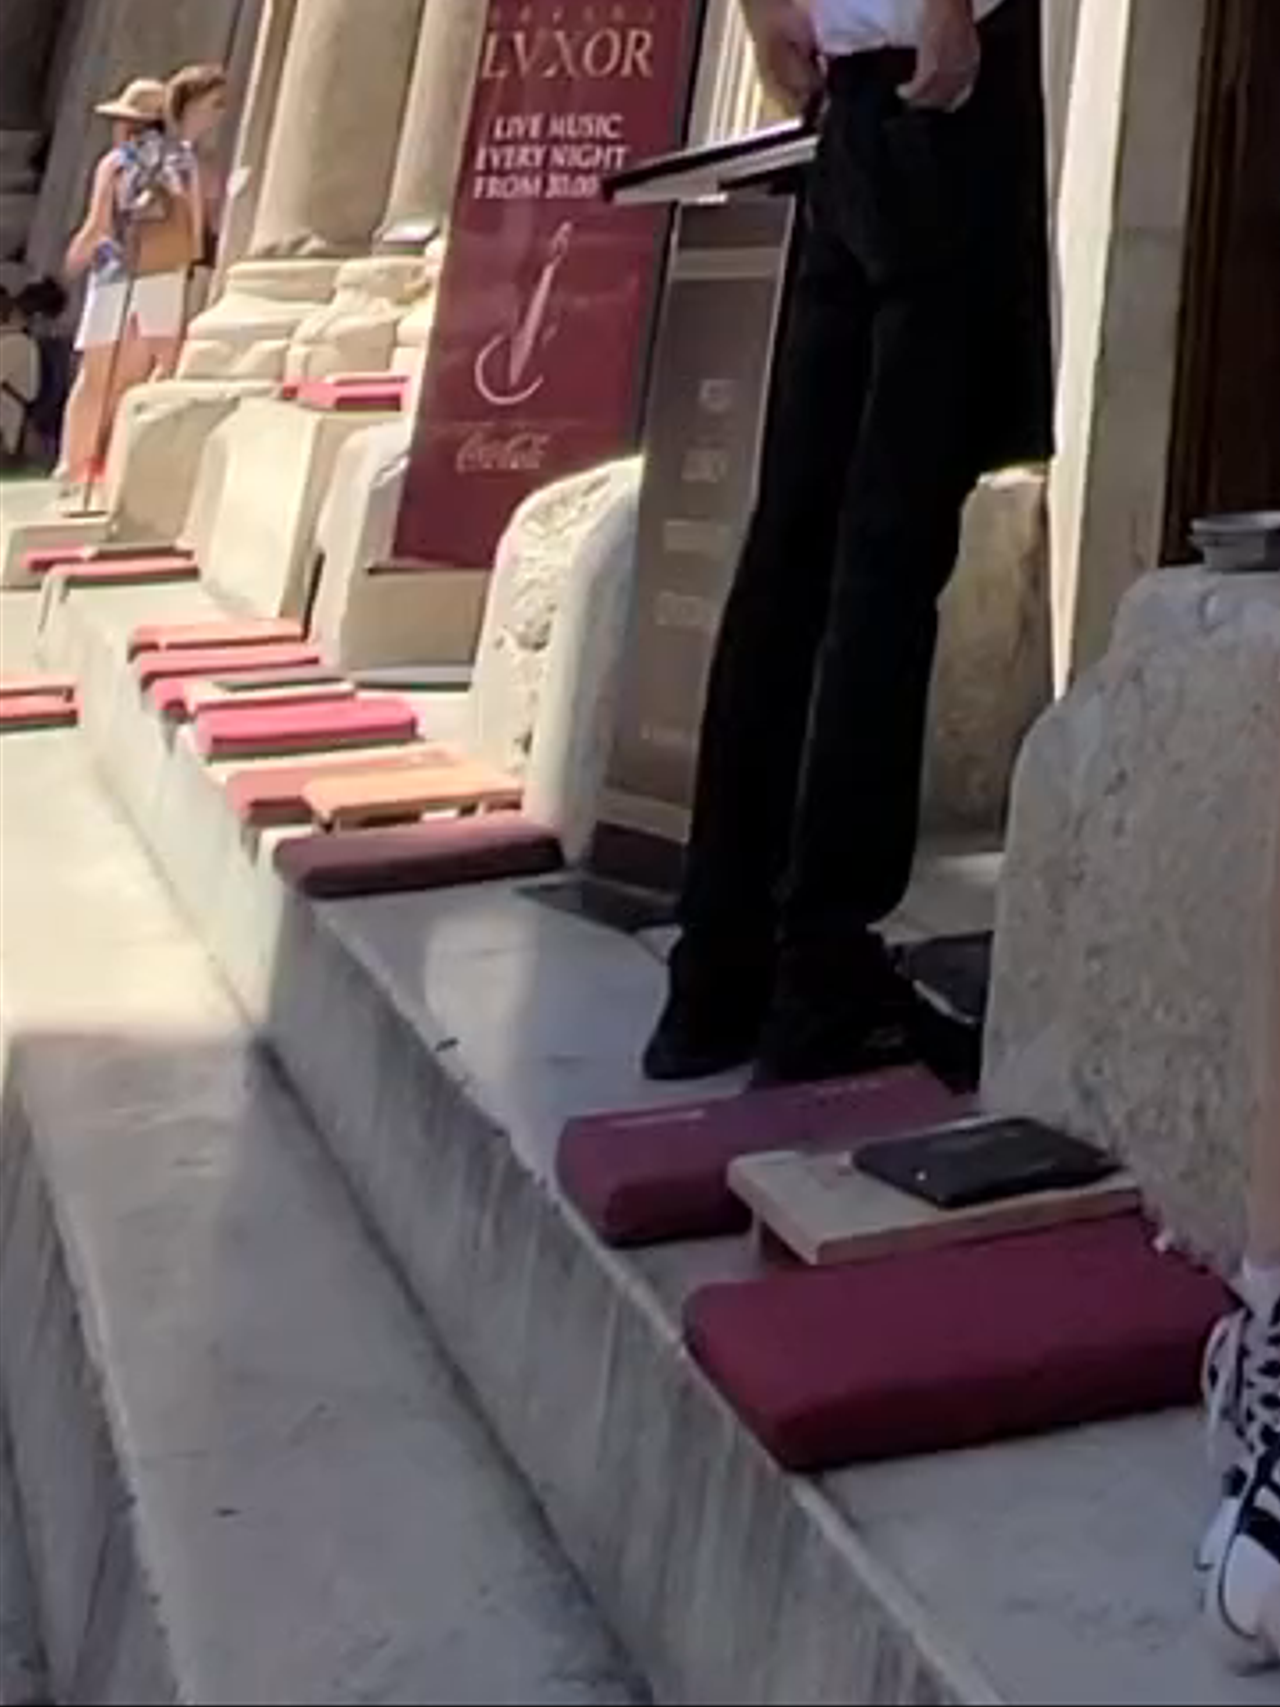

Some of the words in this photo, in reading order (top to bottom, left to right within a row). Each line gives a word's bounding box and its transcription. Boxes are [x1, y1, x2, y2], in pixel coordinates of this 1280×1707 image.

[482, 29, 653, 79] LVXOR
[494, 113, 544, 140] LIVE
[548, 112, 624, 139] MUSIC
[475, 144, 546, 171] EVERY
[549, 144, 630, 170] NIGHT
[474, 175, 542, 199] FROM
